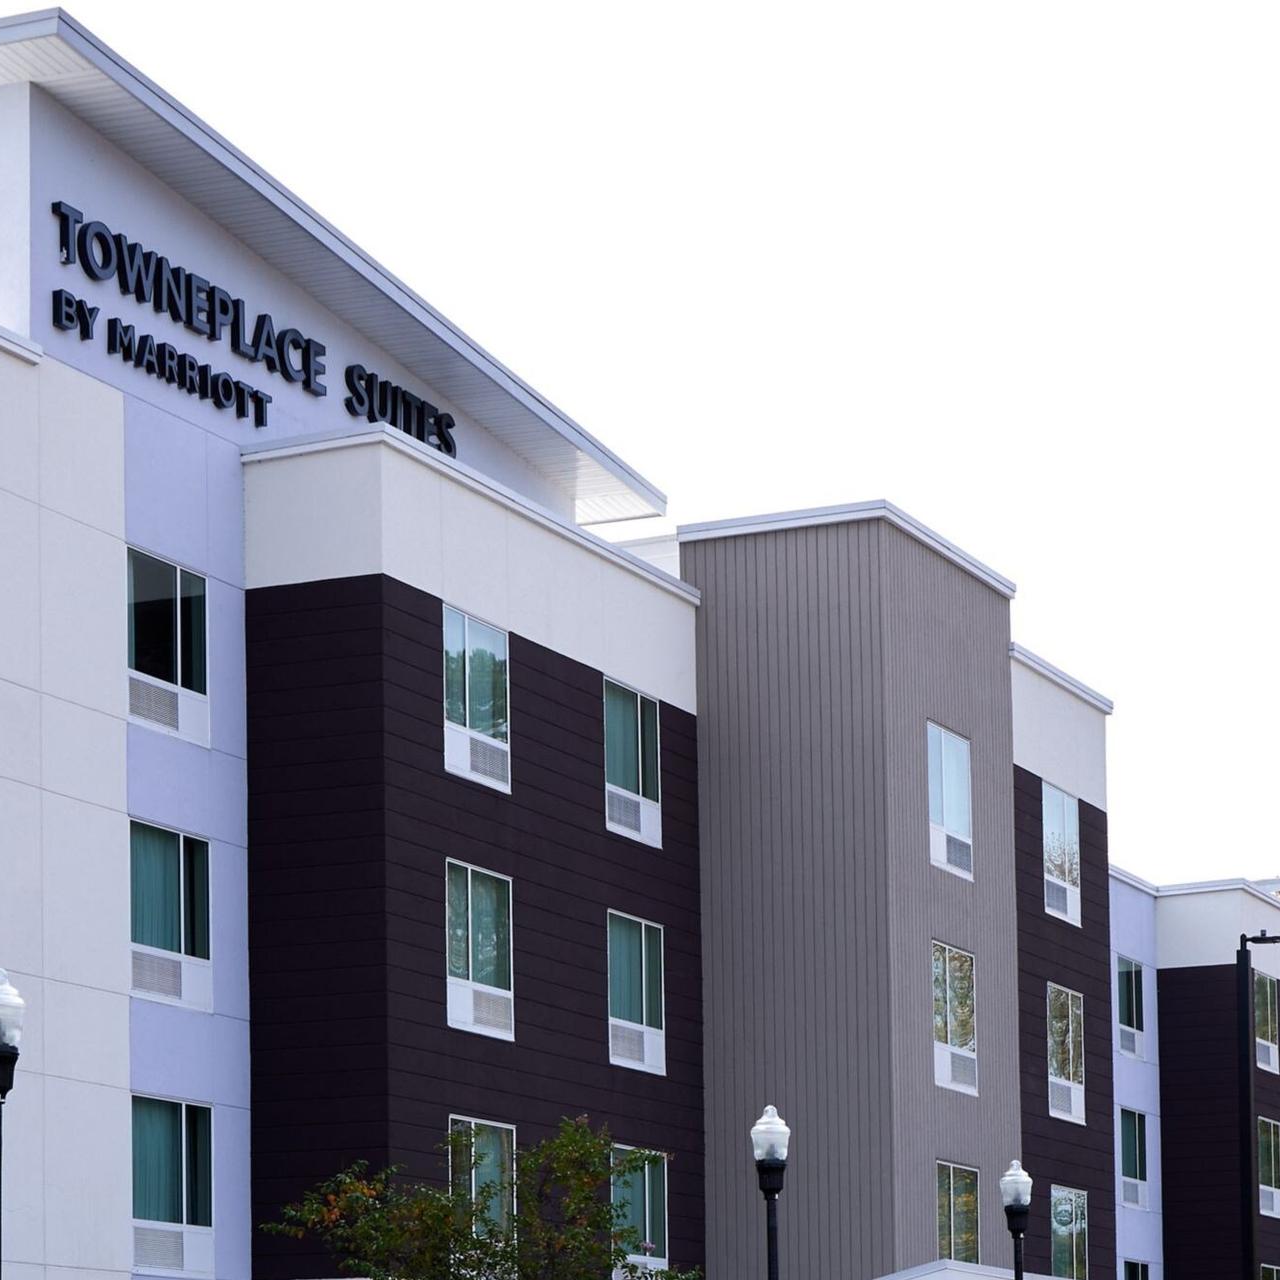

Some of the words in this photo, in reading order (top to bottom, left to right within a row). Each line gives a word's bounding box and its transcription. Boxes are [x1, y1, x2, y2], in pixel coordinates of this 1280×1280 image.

[51, 200, 327, 397] TOWNEPLACE
[344, 364, 457, 459] SUITES
[52, 288, 100, 340] BY
[107, 317, 272, 428] MARRIOTT
